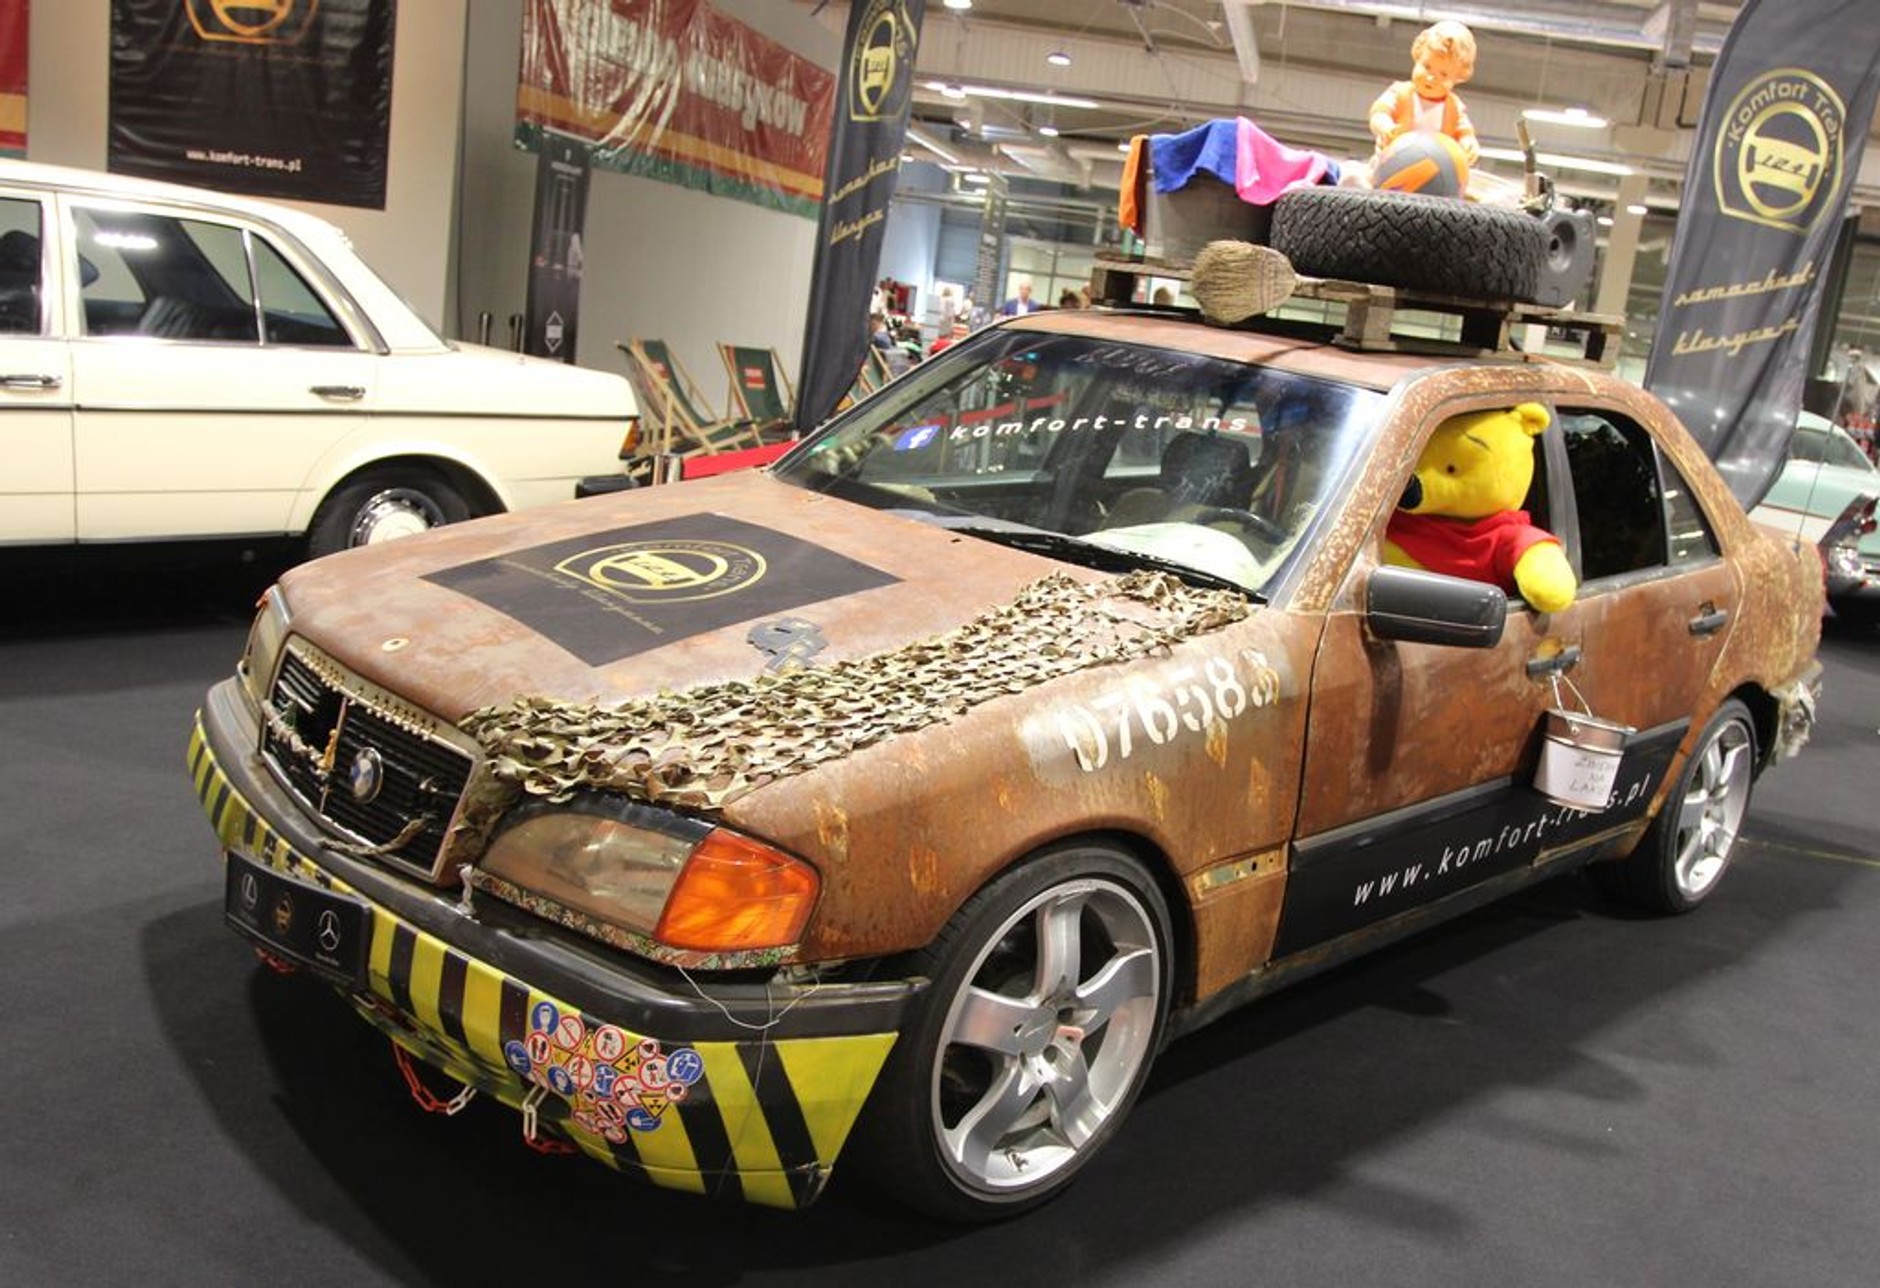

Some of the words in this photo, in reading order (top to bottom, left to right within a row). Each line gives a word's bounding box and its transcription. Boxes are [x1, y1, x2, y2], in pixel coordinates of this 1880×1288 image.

[1728, 81, 1809, 142] Komfort
[1674, 261, 1816, 307] samochod
[950, 414, 1248, 441] komfort-trans
[1353, 773, 1650, 906] www.komfort-trs.pl
